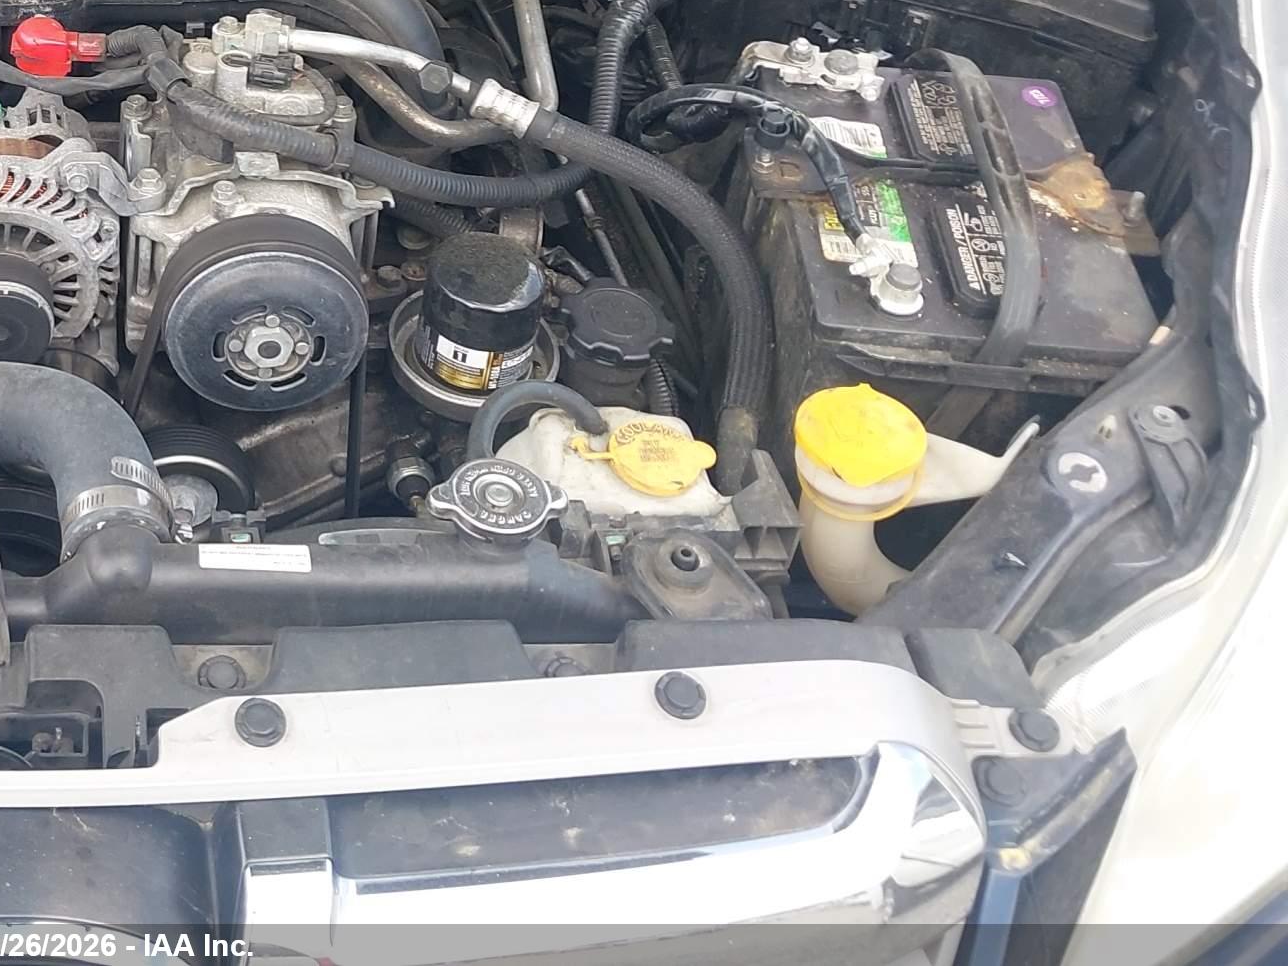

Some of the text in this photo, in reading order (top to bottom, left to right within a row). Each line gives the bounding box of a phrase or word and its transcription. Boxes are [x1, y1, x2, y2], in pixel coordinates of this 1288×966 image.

[945, 208, 965, 239] POISON
[958, 246, 978, 281] DANGER
[615, 421, 686, 445] COOLANT
[479, 509, 532, 525] DANGER
